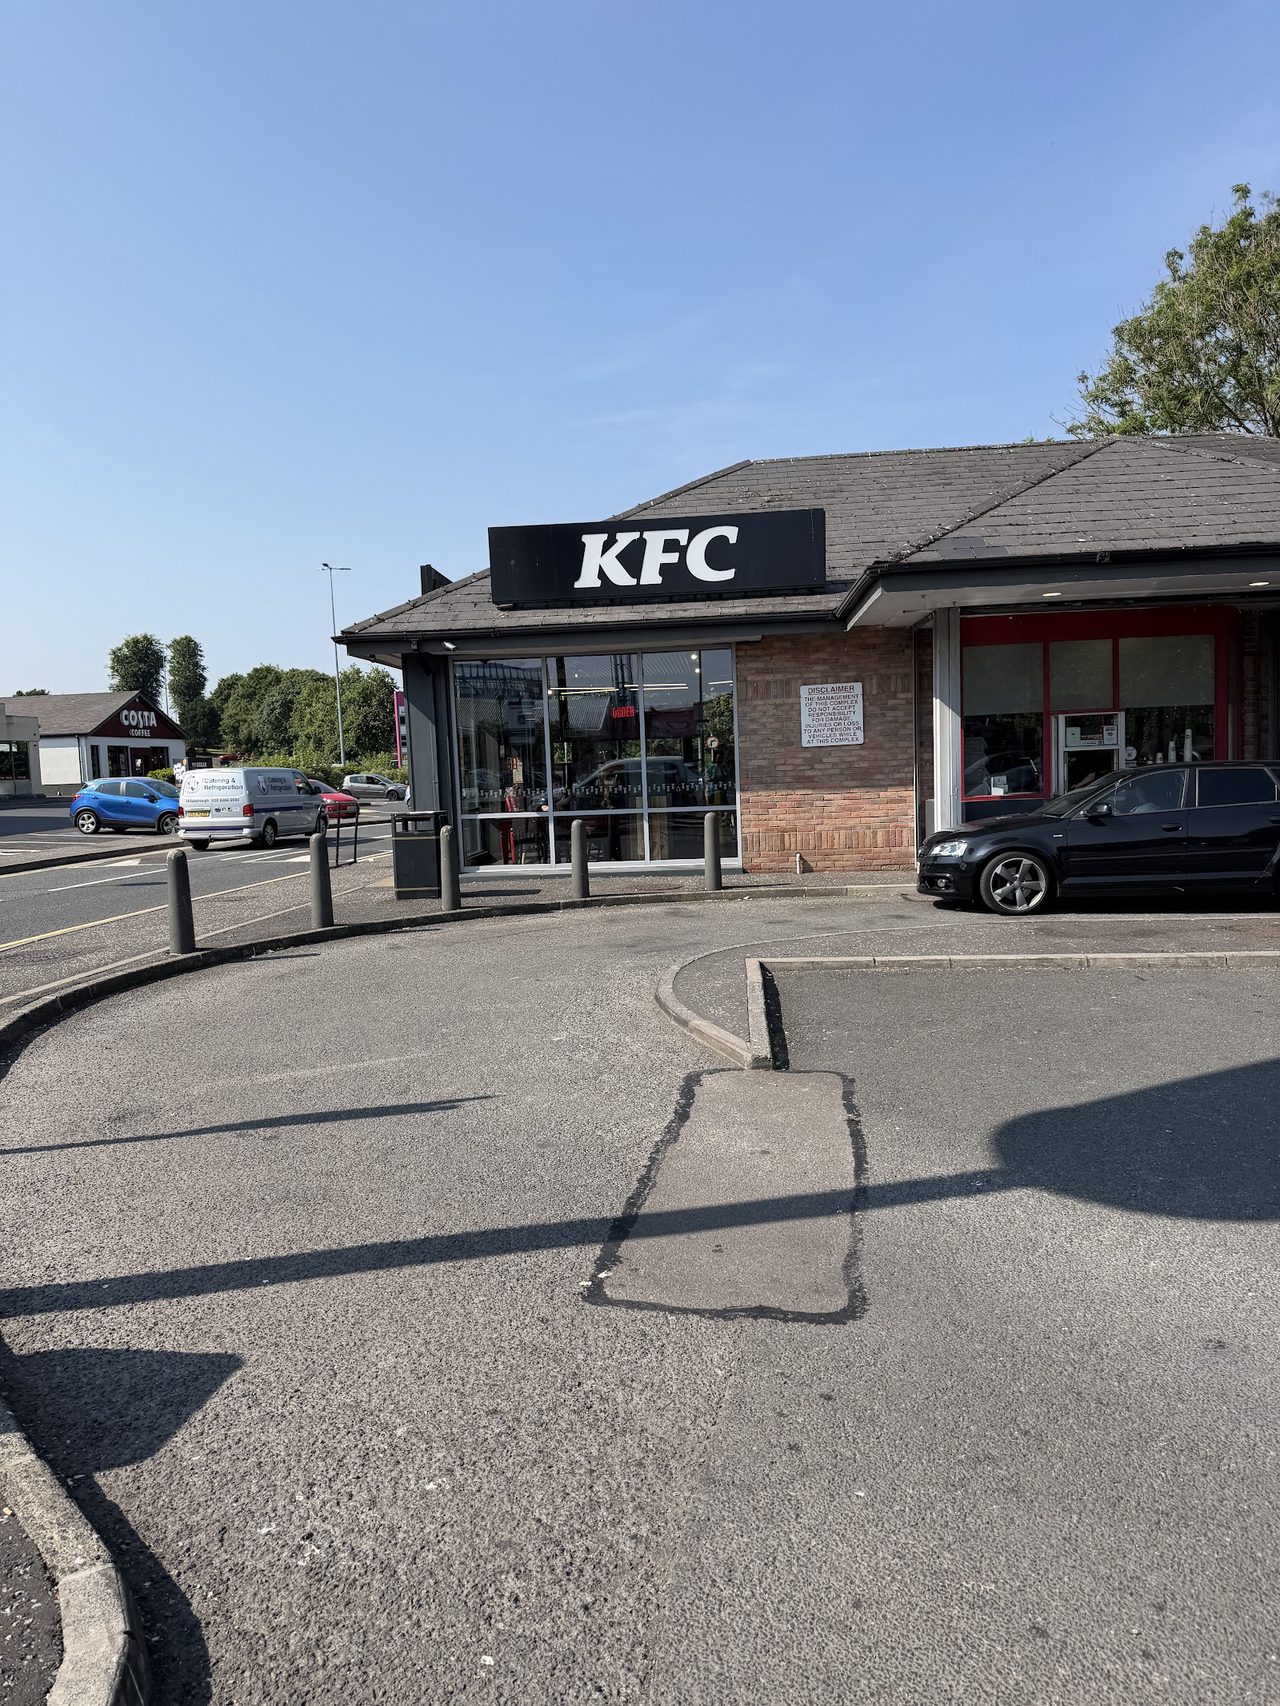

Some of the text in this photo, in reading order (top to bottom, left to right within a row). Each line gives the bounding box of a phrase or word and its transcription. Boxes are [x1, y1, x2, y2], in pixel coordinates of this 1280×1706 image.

[573, 525, 739, 590] KFC
[808, 686, 855, 694] DISCLAIMER
[121, 710, 157, 728] COSTA
[130, 729, 151, 737] COFFEE
